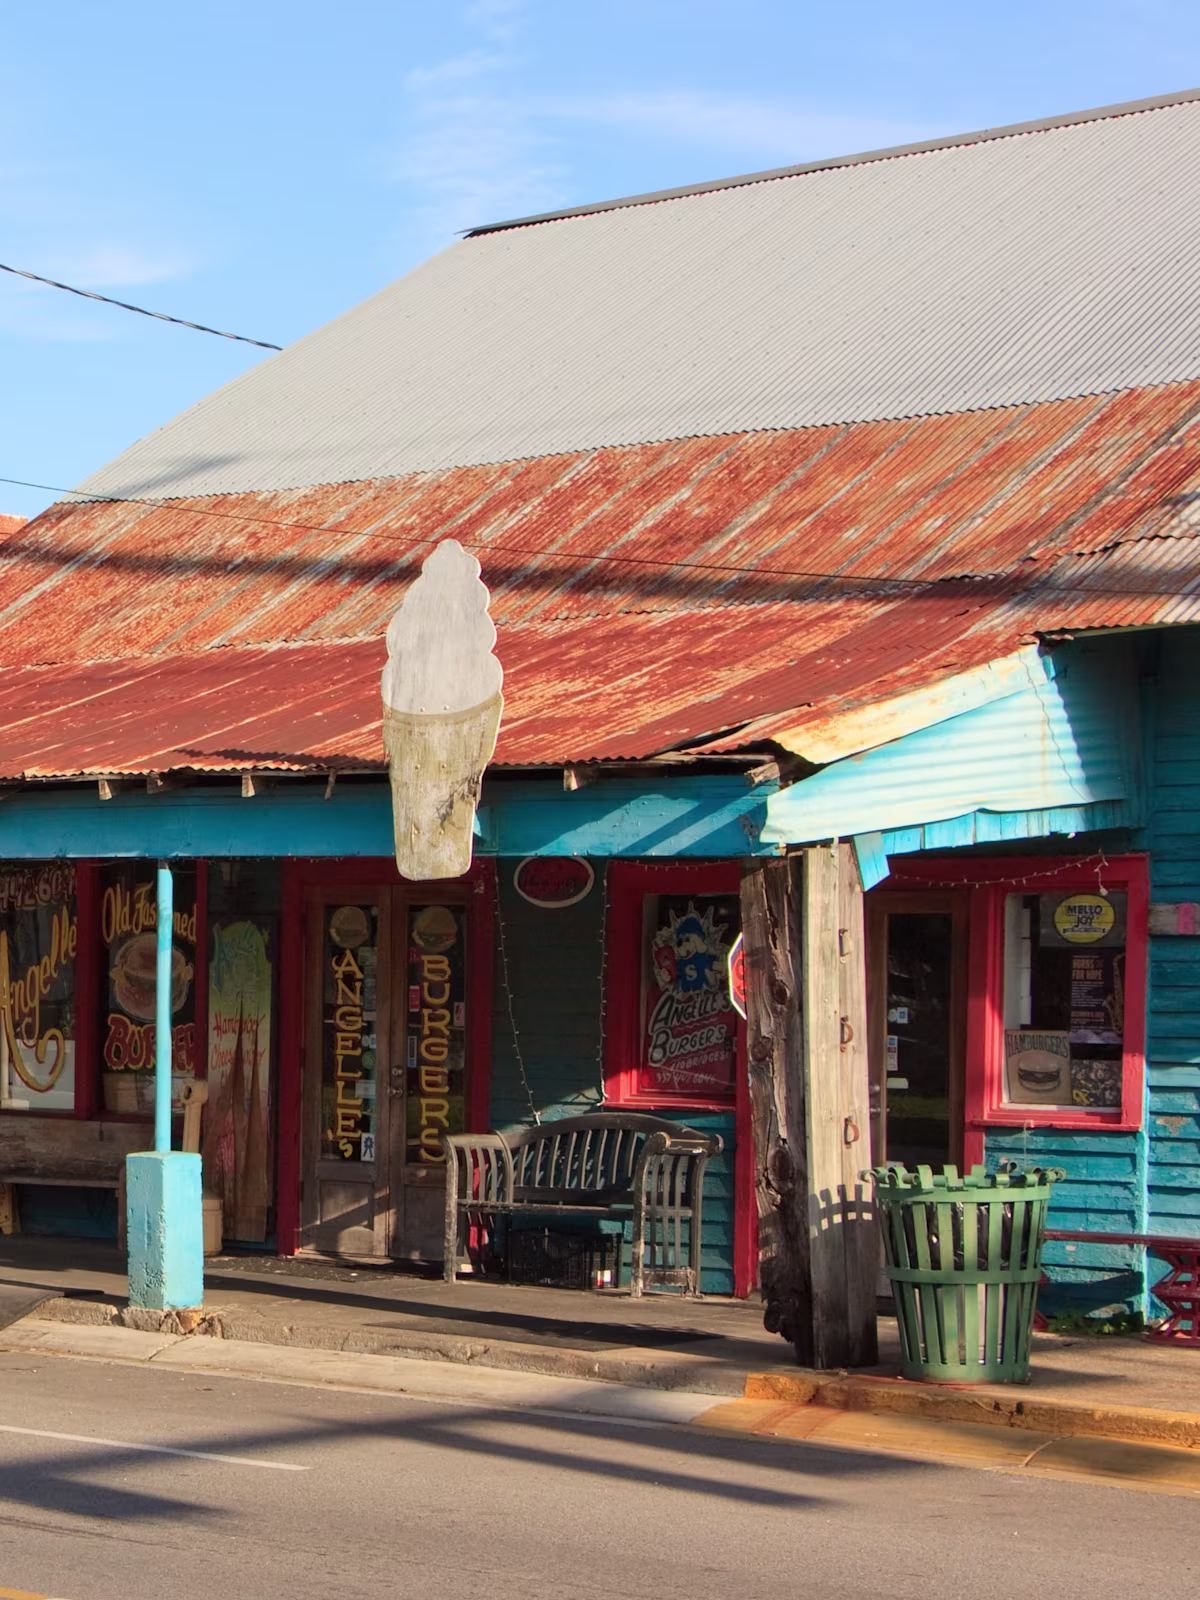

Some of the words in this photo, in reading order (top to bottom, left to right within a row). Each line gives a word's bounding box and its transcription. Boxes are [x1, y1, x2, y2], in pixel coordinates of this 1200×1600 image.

[102, 883, 131, 943] Old
[133, 881, 196, 943] Fasned
[1066, 905, 1103, 915] MELLO
[1075, 915, 1095, 927] JOY
[684, 963, 698, 981] S
[104, 1013, 196, 1071] BURER
[327, 949, 365, 1159] ANGELLE'S
[419, 955, 451, 1163] BURGERS
[648, 1023, 726, 1064] BURGERS
[1006, 1034, 1069, 1058] HAMBURGERS
